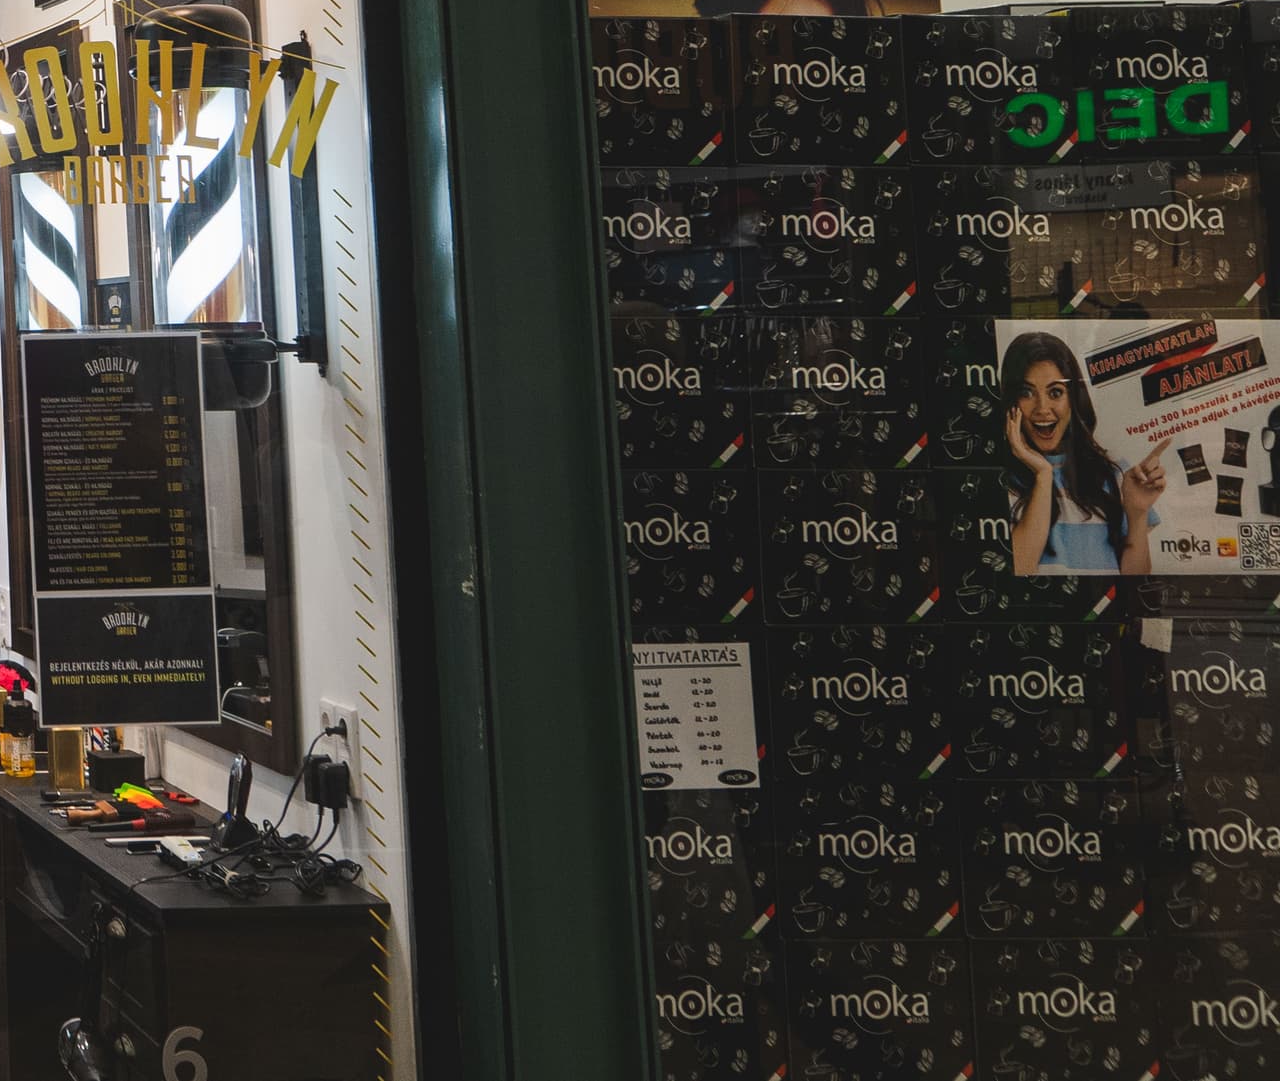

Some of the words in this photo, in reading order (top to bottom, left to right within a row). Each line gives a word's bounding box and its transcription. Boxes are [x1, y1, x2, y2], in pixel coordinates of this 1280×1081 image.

[63, 155, 196, 205] BARBER
[1089, 323, 1216, 376] KIHAGYHATATLAN
[85, 356, 140, 376] BROOKLYN
[1159, 349, 1252, 398] AJÁNLAT!
[1126, 419, 1159, 435] Vegyél
[1161, 412, 1179, 423] 300
[1232, 390, 1243, 399] az
[1148, 419, 1199, 442] ajándékba
[1202, 408, 1229, 425] adjuk
[1161, 534, 1211, 553] moka
[49, 660, 110, 672] BEJELENTKEZÉS
[112, 659, 142, 671] NÉLKÜL,
[144, 657, 164, 669] AKÁR
[166, 659, 204, 669] AZONNAL!
[633, 646, 738, 665] NYITVATARTÁS
[51, 675, 85, 685] WITHOUT
[86, 674, 119, 684] LOGGING
[120, 674, 131, 685] IN,
[133, 674, 152, 683] EVEN
[154, 672, 205, 682] IMMEDIATELY!
